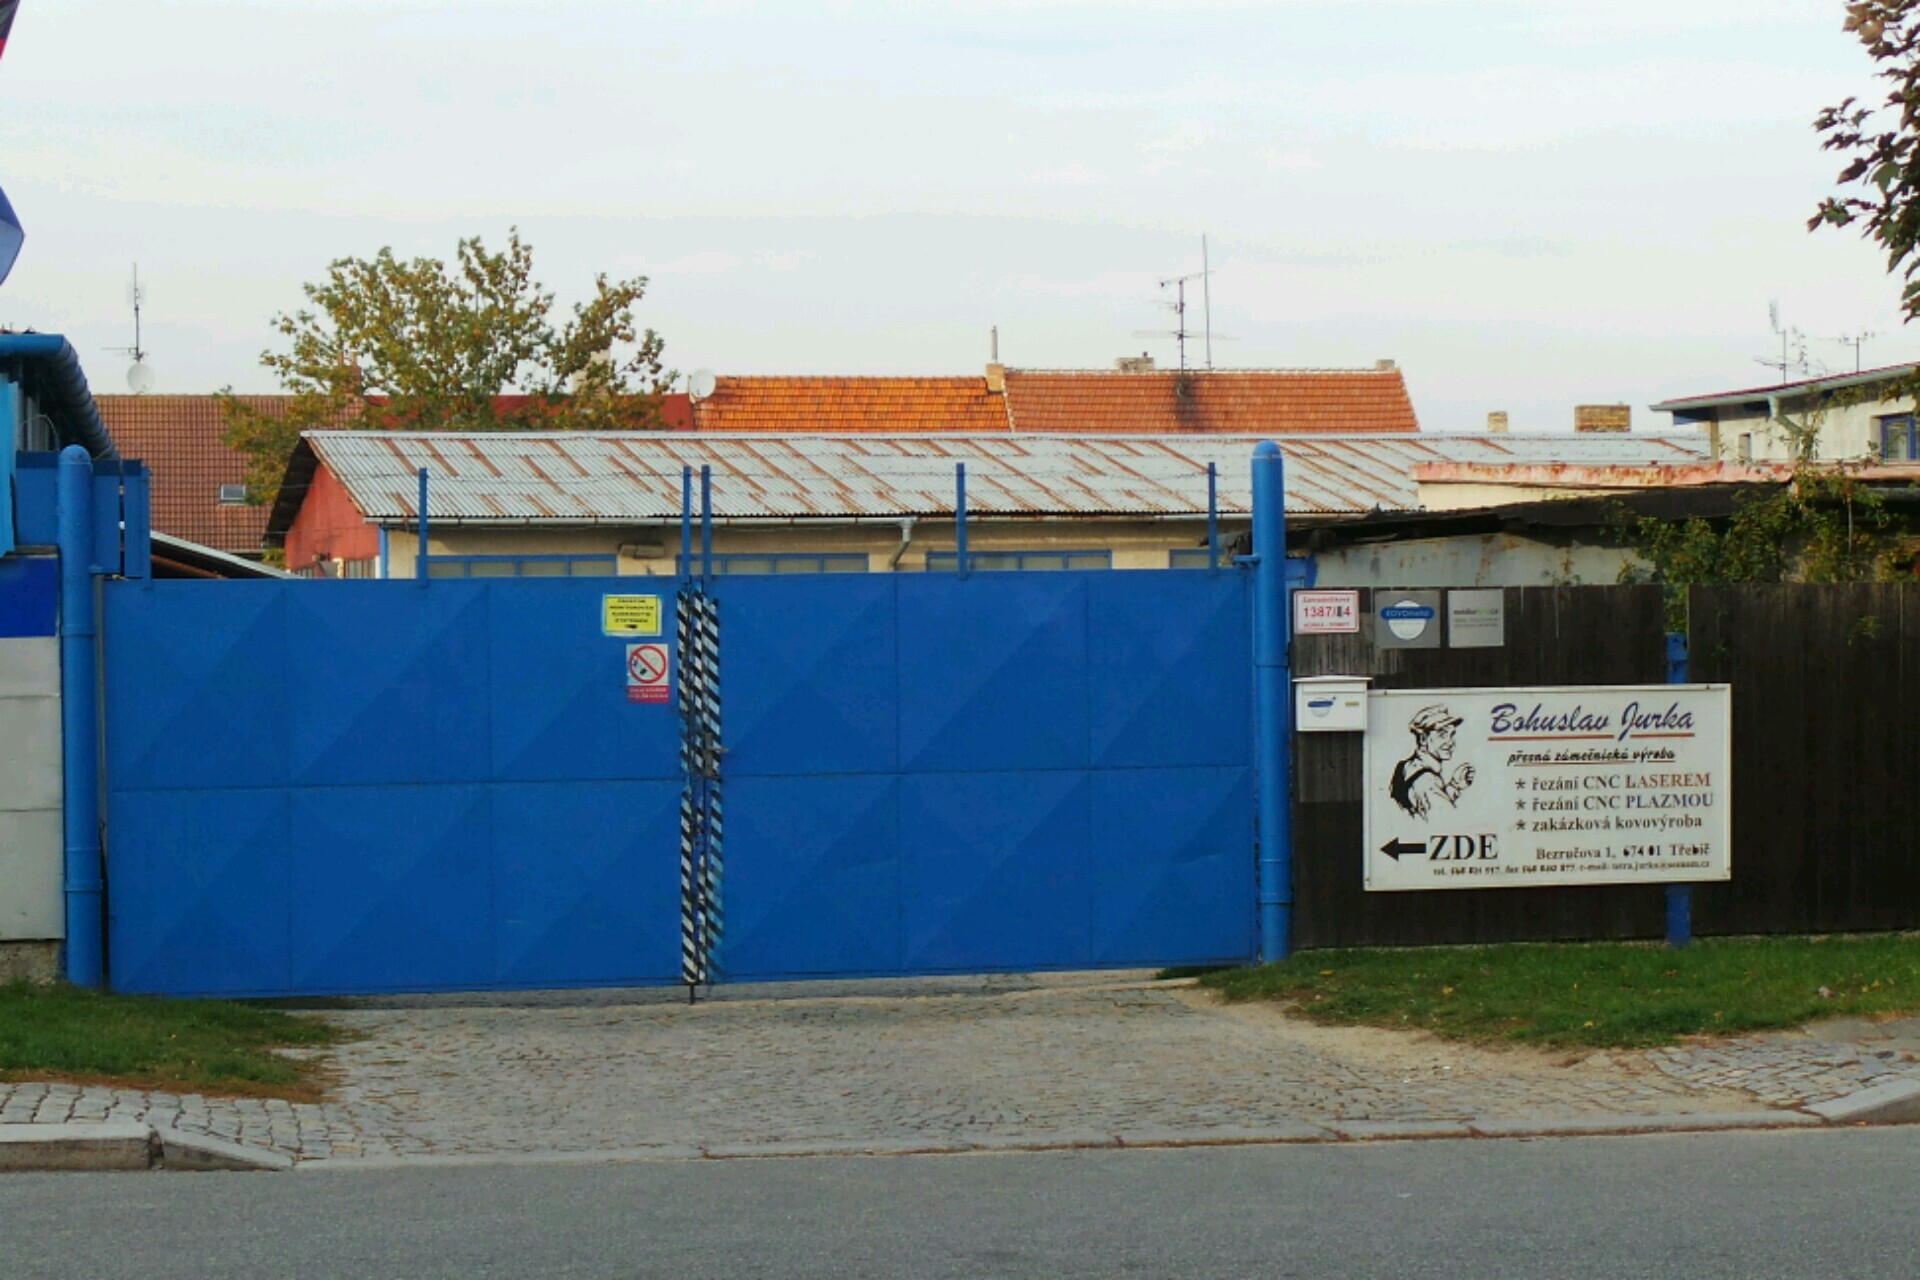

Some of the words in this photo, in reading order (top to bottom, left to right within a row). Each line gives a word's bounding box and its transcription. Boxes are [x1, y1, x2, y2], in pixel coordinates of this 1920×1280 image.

[1491, 702, 1609, 733] Bohuslav
[1618, 701, 1696, 742] Jurka
[1507, 749, 1551, 766] přesná
[1554, 748, 1629, 762] zámečnická
[1632, 746, 1676, 763] výroba
[1532, 776, 1579, 791] řezání
[1583, 774, 1621, 790] CNC
[1625, 772, 1711, 789] LASEREM
[1532, 796, 1579, 811] řezání
[1583, 795, 1621, 810] CNC
[1626, 793, 1714, 809] PLAZMOU
[1532, 816, 1611, 832] zakázková
[1615, 813, 1703, 832] kovovýroba
[1429, 833, 1498, 860] ZDE
[1536, 847, 1600, 860] Bezručova
[1623, 845, 1644, 857] 674
[1669, 842, 1709, 856] Třebíč
